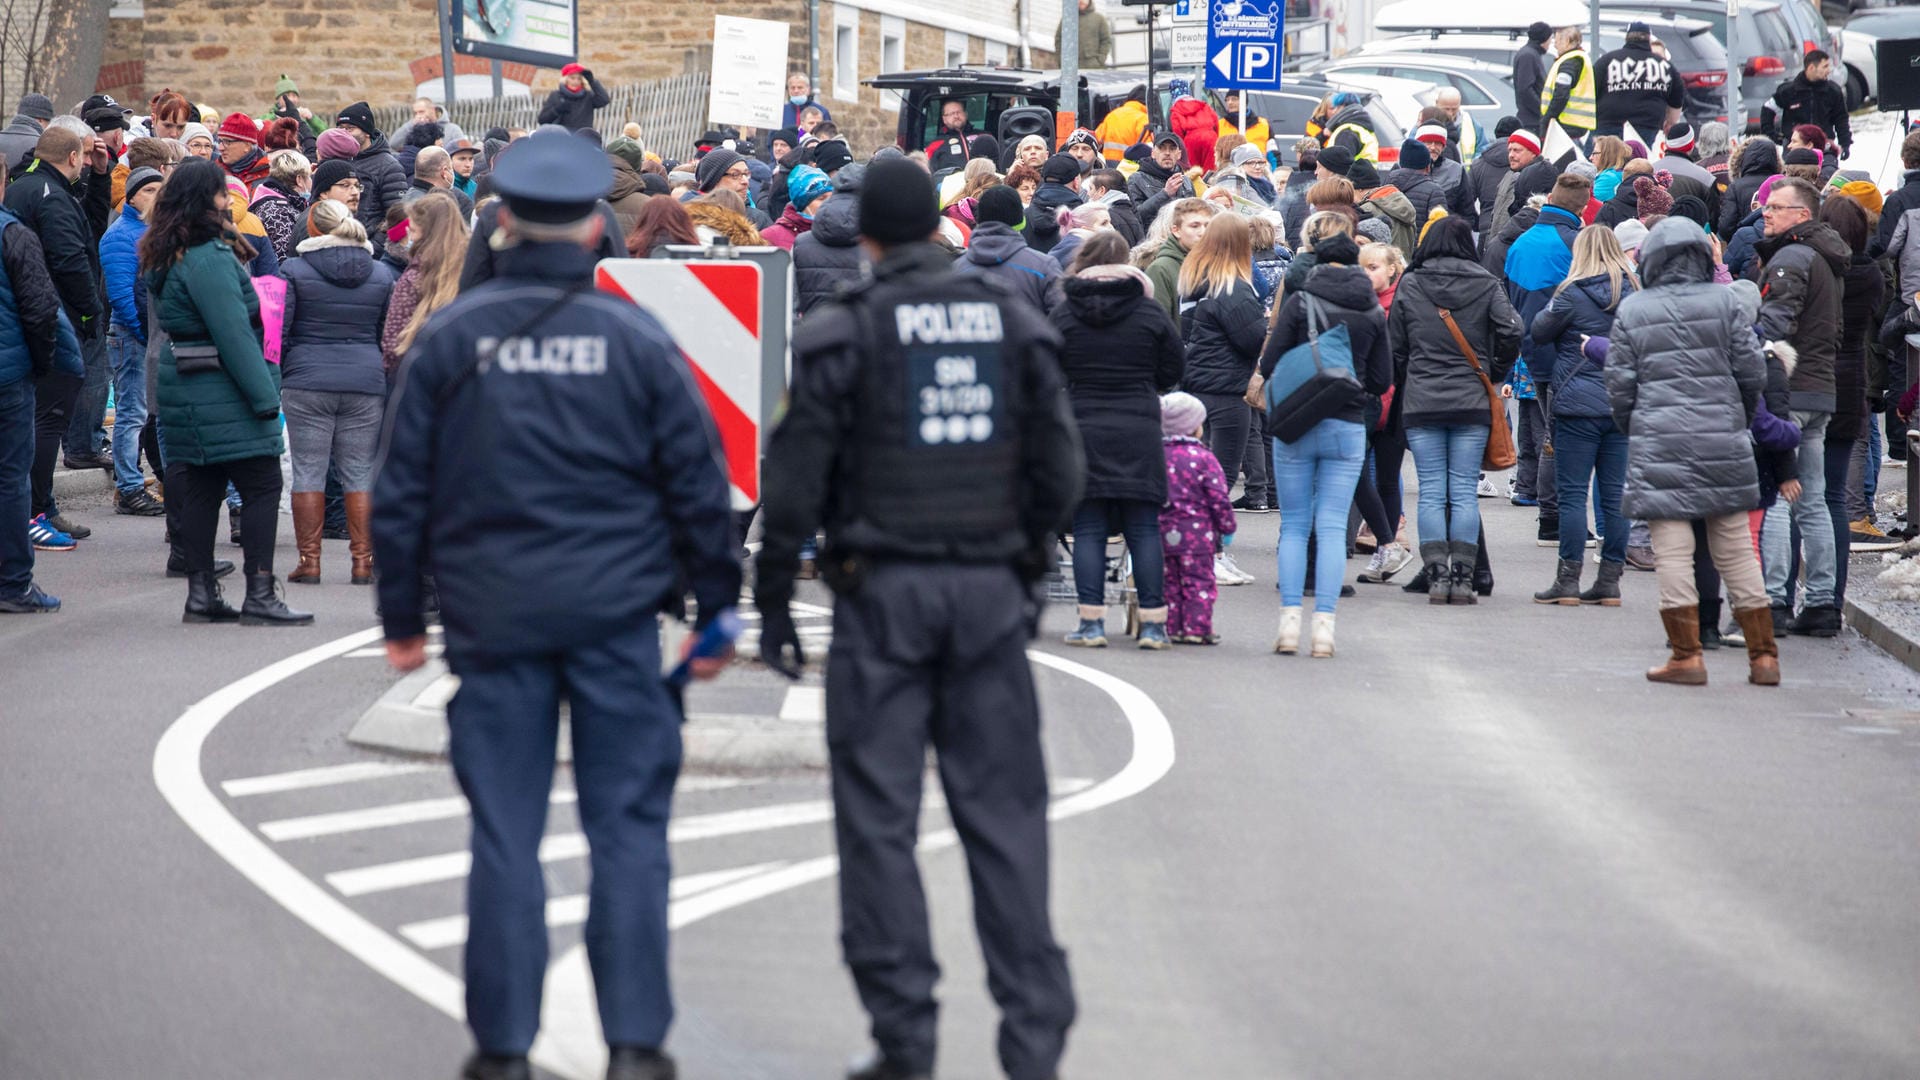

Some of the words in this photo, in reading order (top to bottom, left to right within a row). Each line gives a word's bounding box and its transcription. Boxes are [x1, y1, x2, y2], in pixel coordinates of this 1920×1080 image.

[1176, 32, 1207, 42] Bewohn
[1243, 46, 1270, 78] P
[1607, 56, 1672, 84] AC/DC
[1607, 81, 1630, 93] BACK
[1631, 81, 1642, 90] IN
[1644, 81, 1669, 92] BLACK
[894, 301, 1004, 345] POLIZEI
[934, 355, 977, 386] SN
